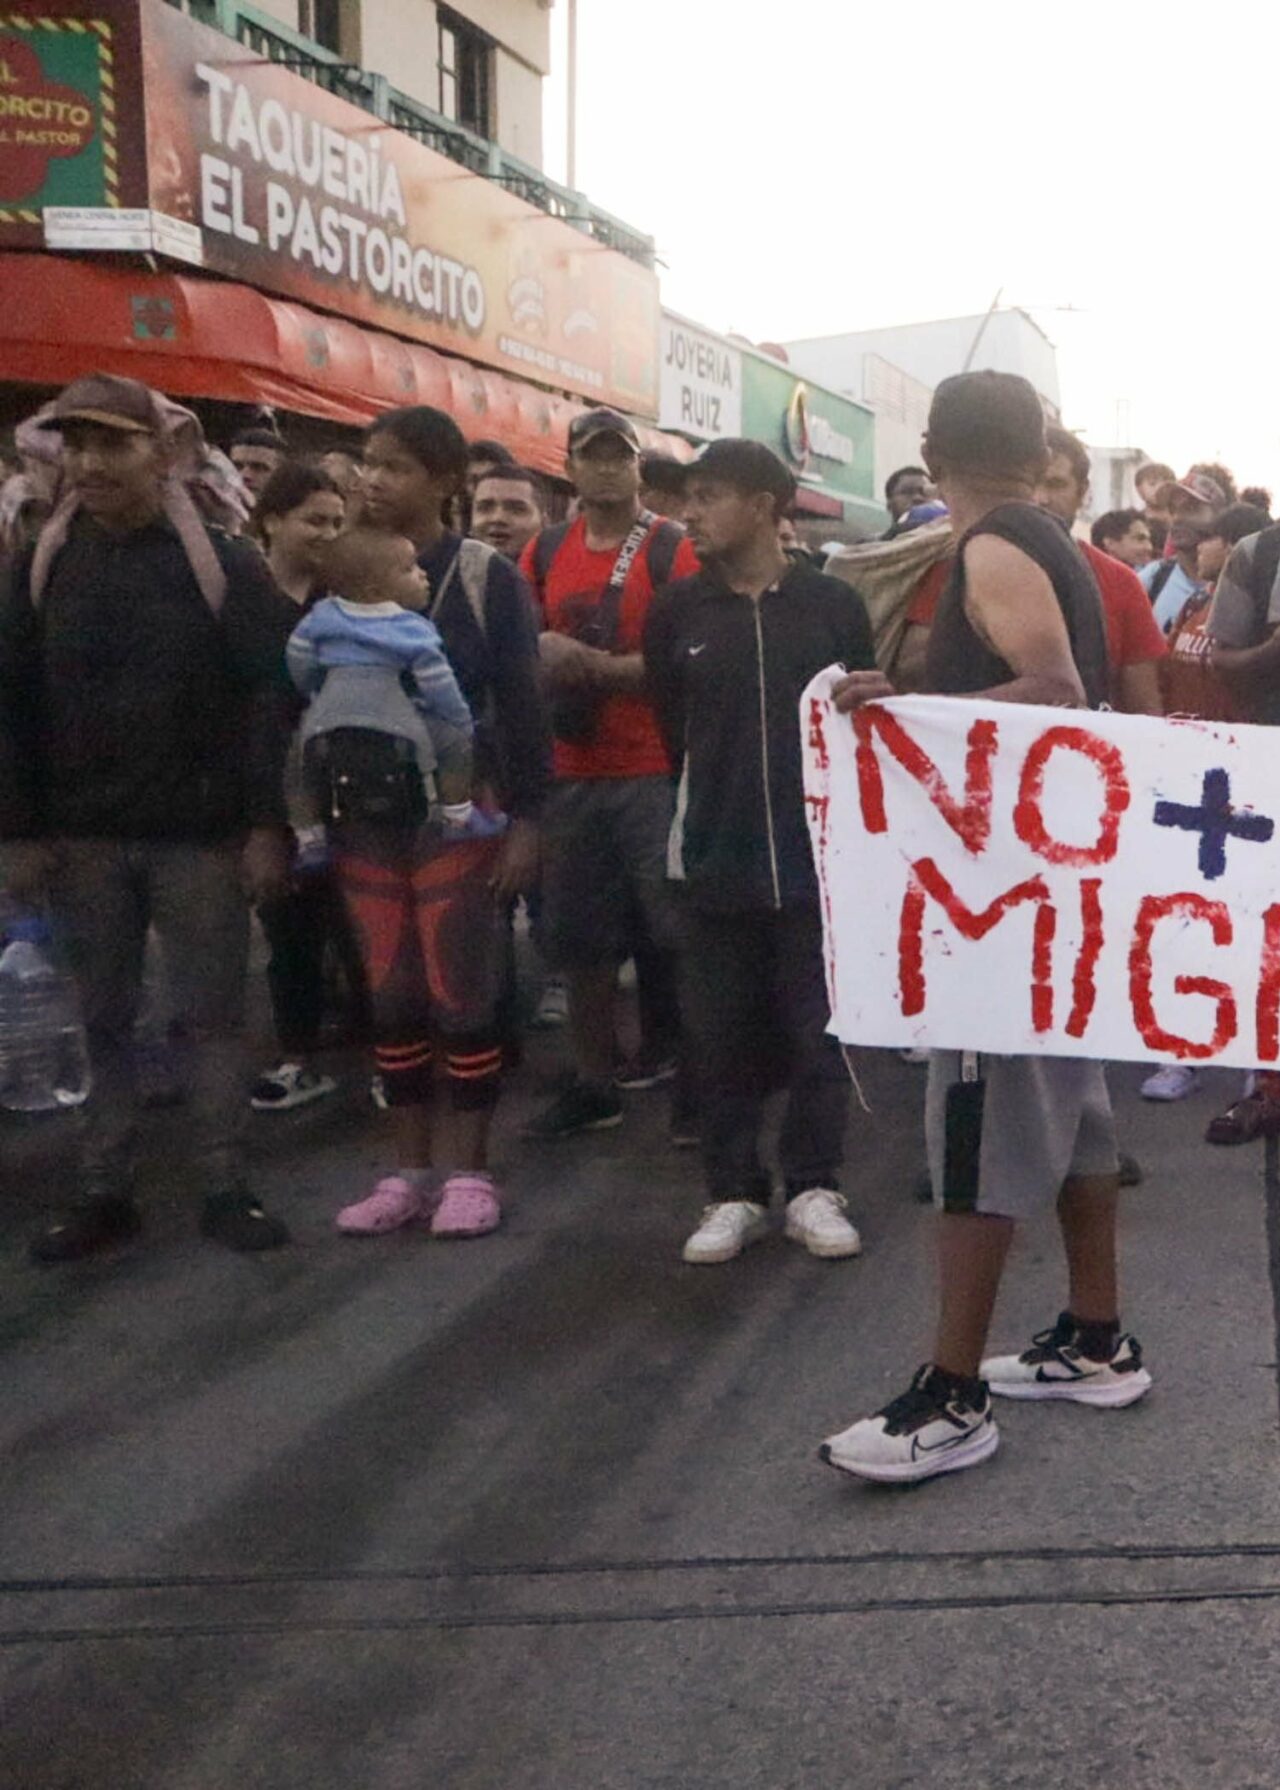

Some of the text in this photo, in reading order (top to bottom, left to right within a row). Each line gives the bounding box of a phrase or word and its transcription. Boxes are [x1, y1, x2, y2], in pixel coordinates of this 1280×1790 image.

[201, 154, 485, 329] EL PASTORCITO
[682, 385, 721, 433] RUIZ
[850, 703, 1131, 868] NO
[1152, 766, 1276, 881] +
